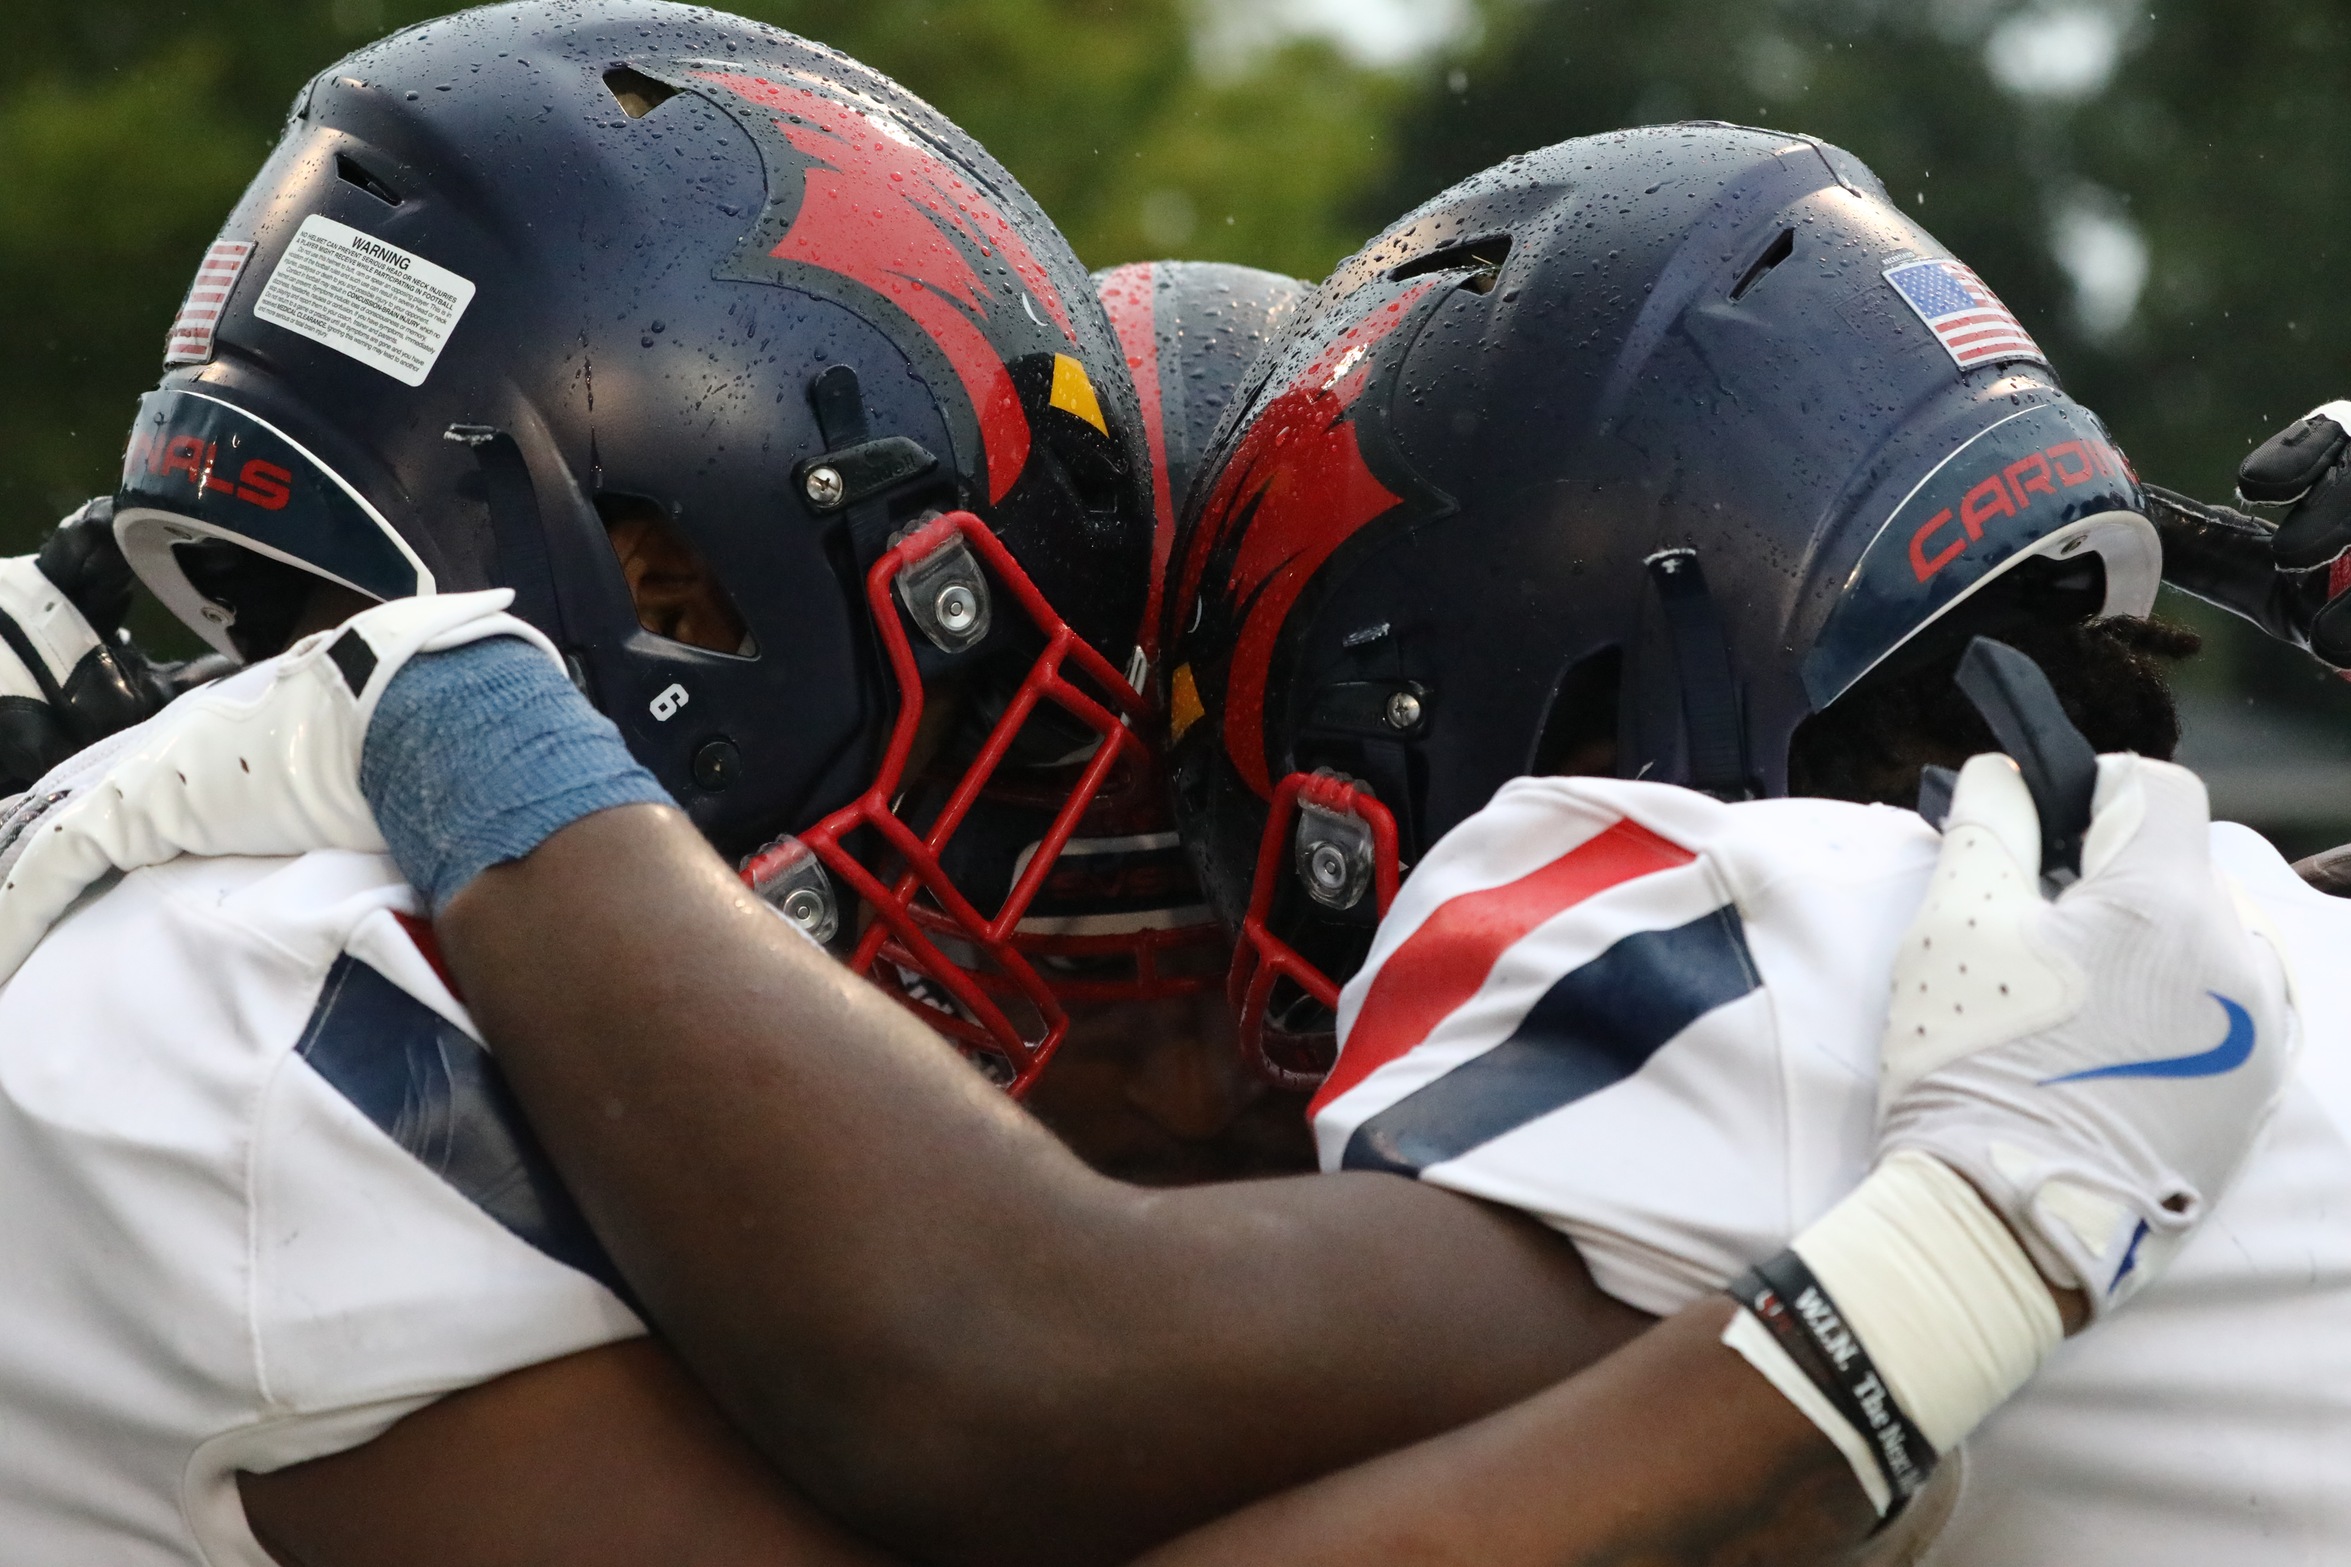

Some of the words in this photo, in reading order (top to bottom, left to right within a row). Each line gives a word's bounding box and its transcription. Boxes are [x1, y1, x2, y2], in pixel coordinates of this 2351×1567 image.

[300, 239, 318, 250] PLAYER
[318, 246, 334, 256] MIGHT
[334, 252, 357, 265] RECEIVE
[356, 261, 374, 273] WHILE
[373, 269, 416, 291] PARTICIPATING
[421, 291, 455, 310] FOOTBALL
[307, 233, 327, 245] HELMET
[326, 241, 338, 249] CAN
[337, 245, 362, 259] PREVENT
[361, 255, 386, 270] SERIOUS
[385, 266, 403, 277] HEAD
[412, 278, 429, 289] NECK
[428, 286, 458, 303] INJURIES
[351, 236, 412, 270] WARNING
[276, 288, 291, 298] playing
[298, 296, 311, 305] report
[327, 309, 338, 317] your
[337, 313, 353, 323] coach,
[353, 320, 369, 329] trainer
[286, 266, 301, 276] Contact
[305, 274, 320, 283] football
[329, 284, 342, 293] result
[399, 315, 420, 328] INJURY
[419, 325, 434, 335] which
[311, 284, 334, 299] Symptoms
[365, 309, 400, 327] consciousness
[315, 261, 330, 271] football
[349, 276, 361, 284] such
[378, 289, 393, 298] result
[397, 298, 415, 308] severe
[414, 305, 428, 315] head
[433, 315, 448, 324] neck
[320, 272, 333, 280] death
[355, 287, 375, 299] possible
[374, 296, 388, 305] injury
[393, 304, 405, 313] your
[326, 258, 341, 267] helmet
[370, 277, 384, 287] spear
[389, 286, 414, 301] opposing
[429, 303, 442, 313] This
[275, 312, 290, 321] serious
[304, 324, 315, 332] brain
[276, 303, 297, 316] MEDICAL
[326, 325, 345, 337] Ignoring
[352, 337, 373, 350] warning
[371, 346, 383, 355] may
[383, 351, 395, 359] lead
[277, 296, 289, 304] return
[296, 304, 309, 313] game
[313, 311, 331, 322] practice
[345, 325, 370, 340] symptoms
[377, 341, 391, 350] gone
[391, 346, 402, 354] and
[400, 351, 412, 360] you
[411, 356, 425, 366] have
[310, 293, 326, 303] nausea
[356, 314, 367, 322] you
[366, 317, 379, 326] have
[403, 335, 437, 355] immediately
[649, 683, 690, 722] 6
[1853, 1371, 1890, 1429] The
